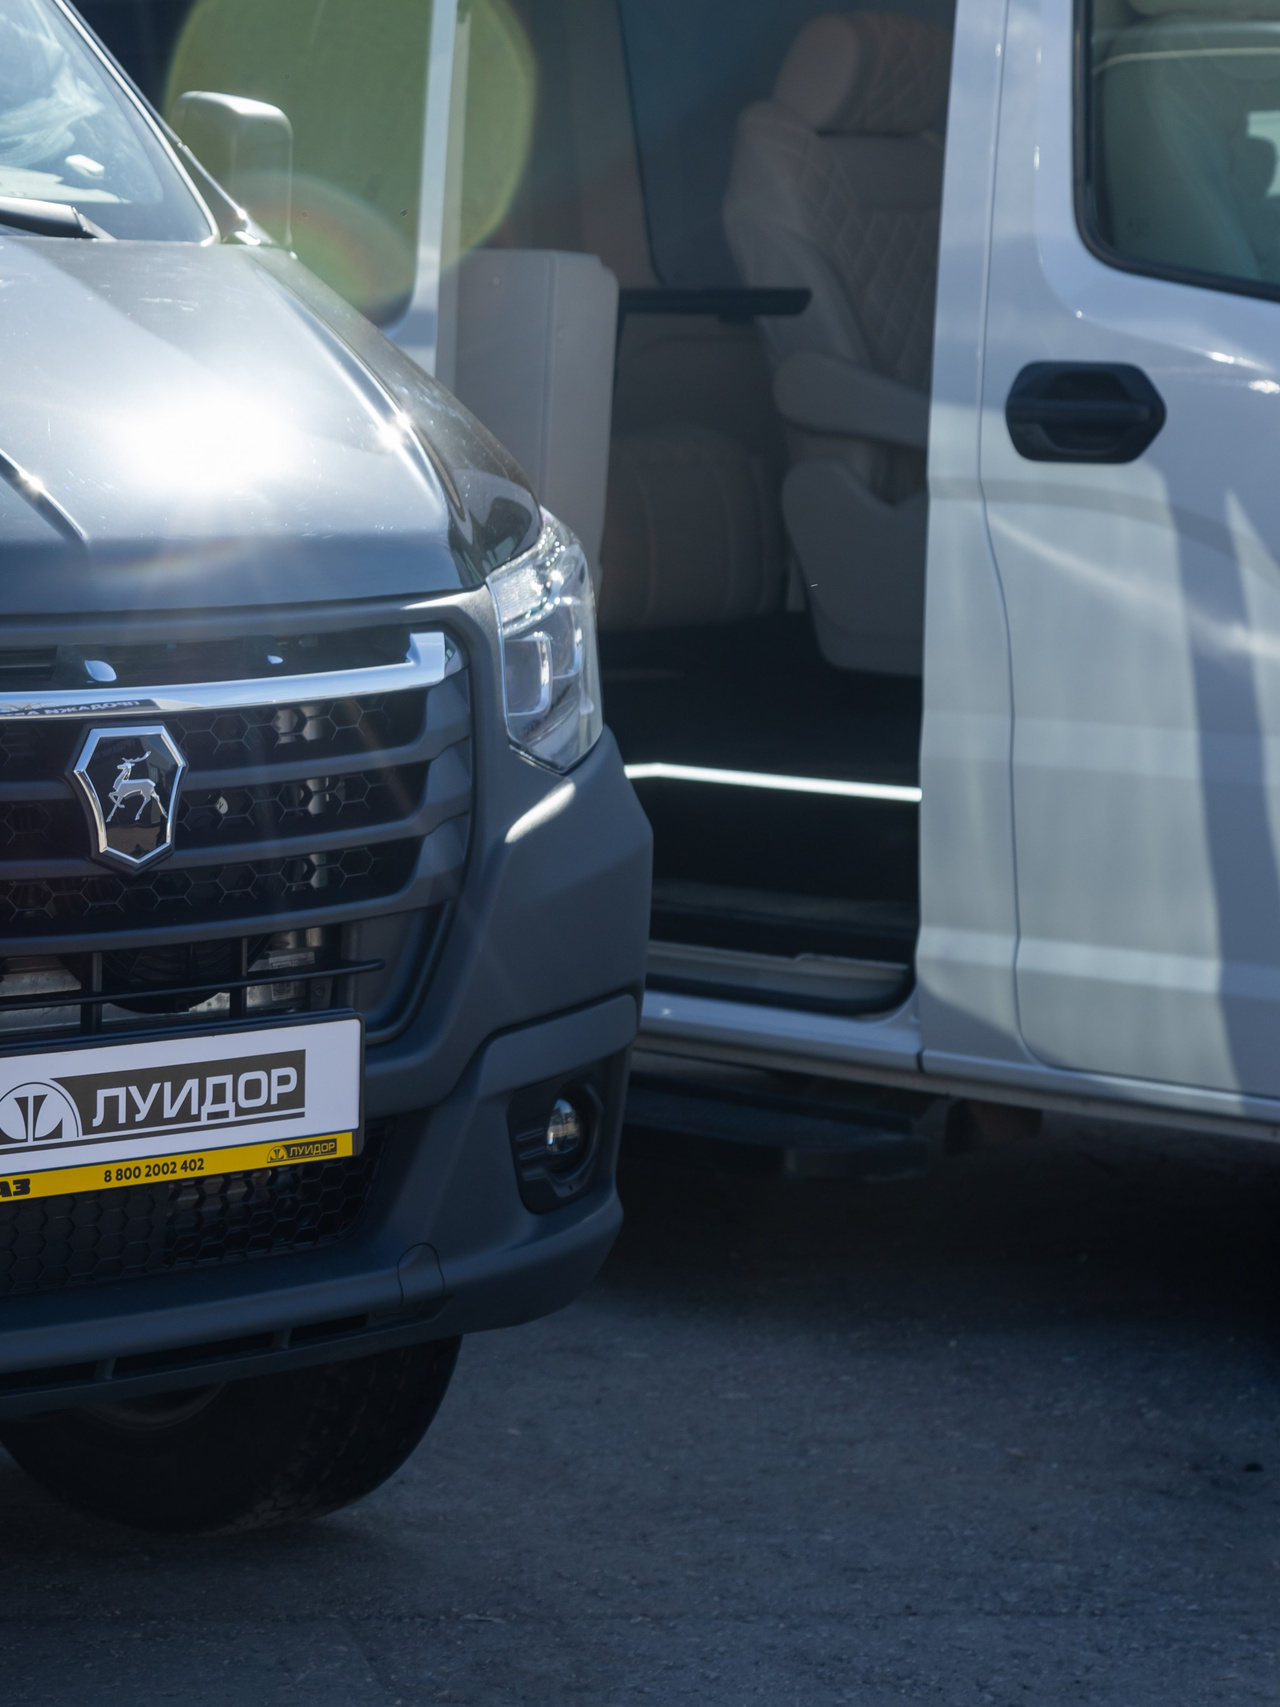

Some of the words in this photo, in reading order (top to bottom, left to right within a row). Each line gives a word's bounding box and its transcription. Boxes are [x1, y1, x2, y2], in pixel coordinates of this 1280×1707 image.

[92, 1067, 297, 1127] ЛУИДОР
[290, 1142, 335, 1156] ЛУИДОР
[104, 1170, 113, 1183] 8
[115, 1166, 141, 1181] 800
[144, 1161, 177, 1177] 2002
[180, 1158, 205, 1172] 402
